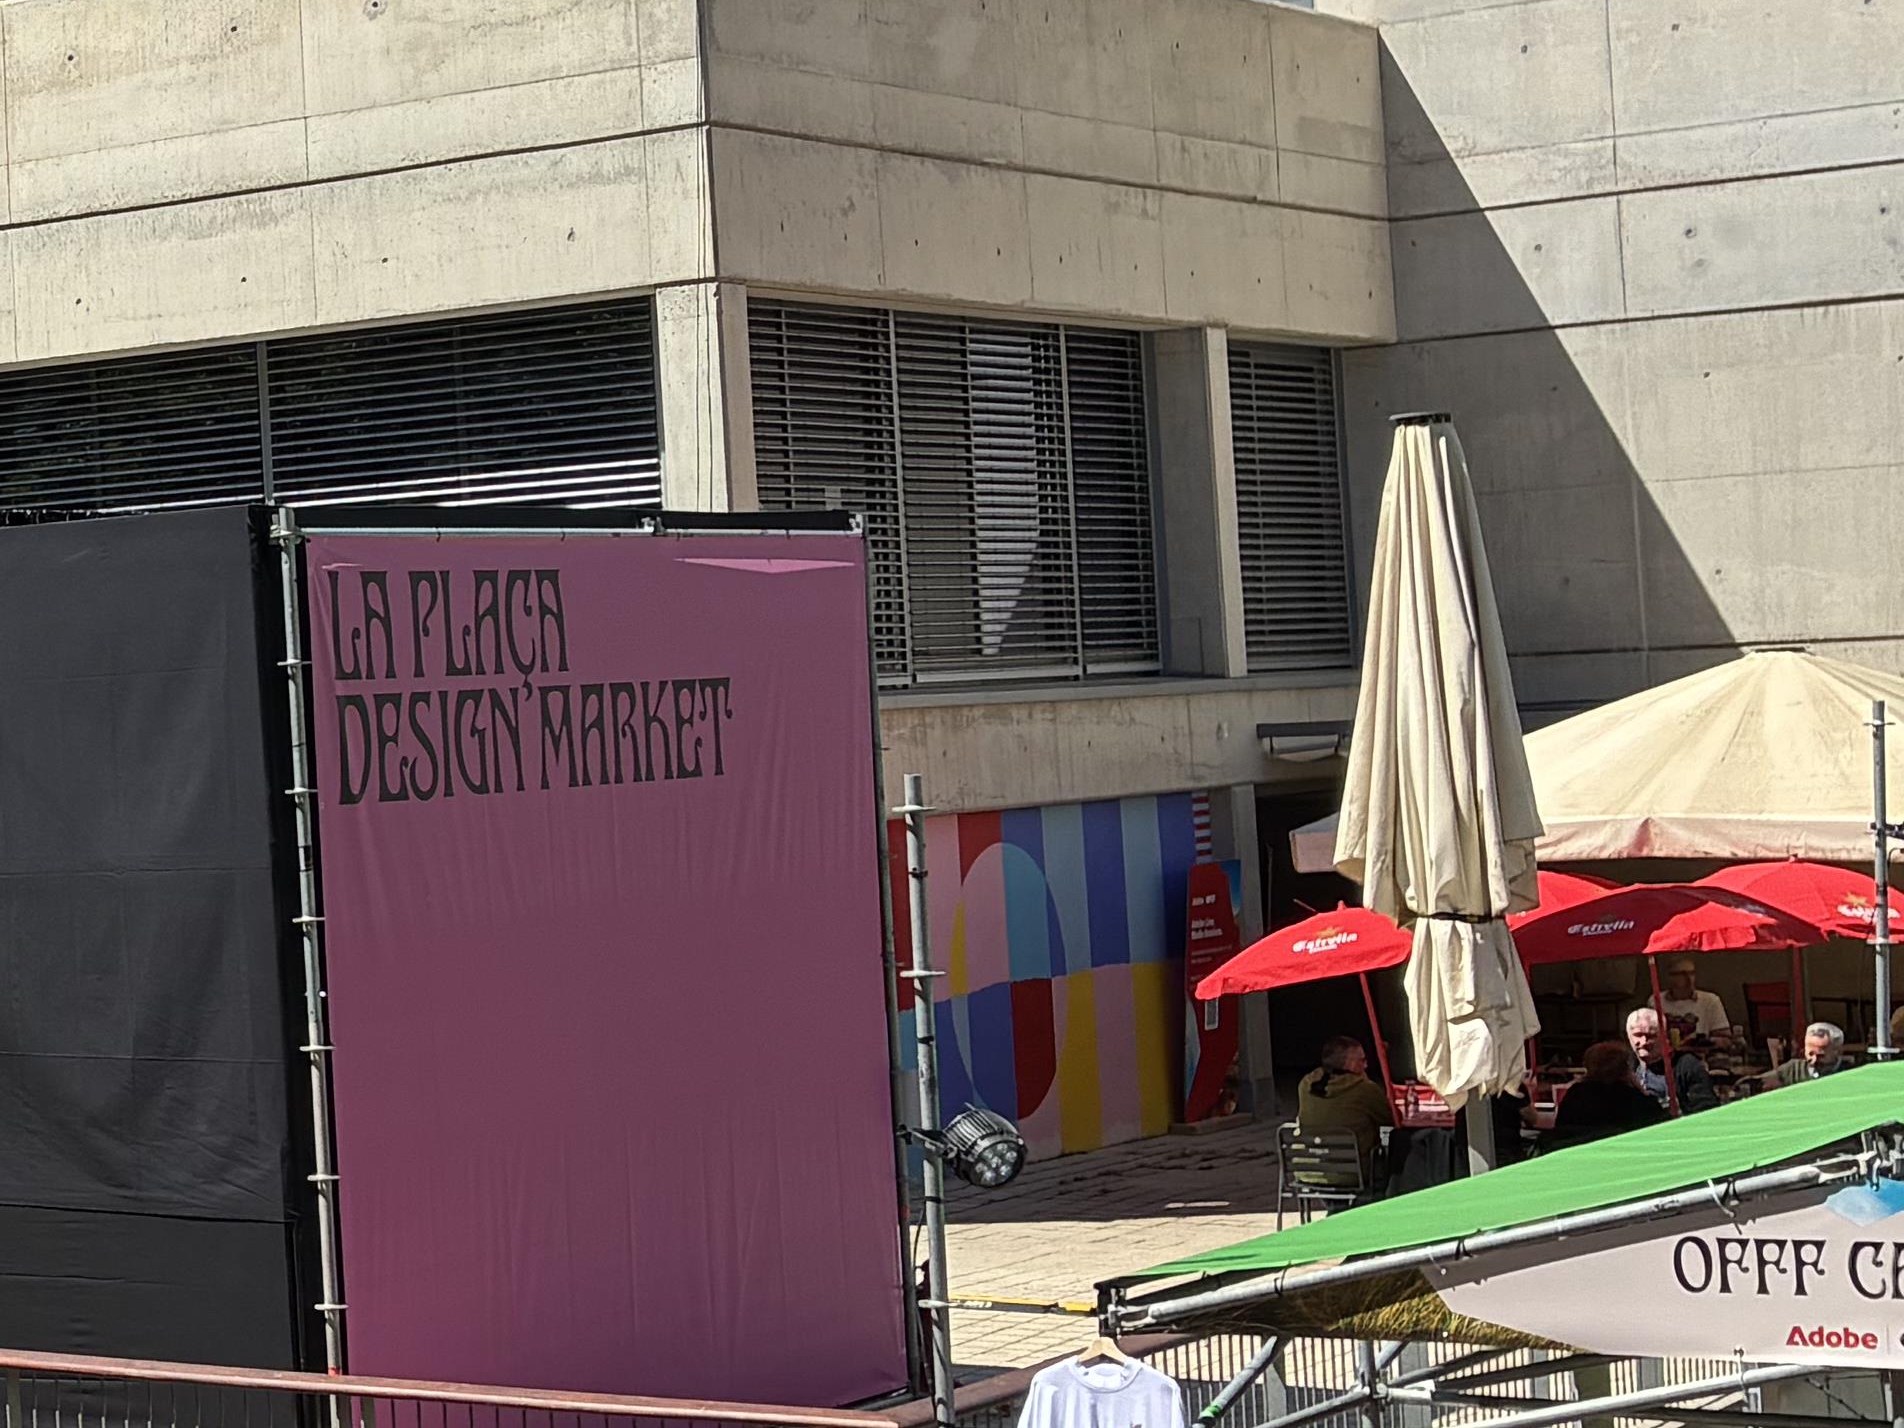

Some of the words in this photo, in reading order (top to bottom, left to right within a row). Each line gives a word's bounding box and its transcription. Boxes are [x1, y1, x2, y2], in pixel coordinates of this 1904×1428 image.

[327, 570, 394, 681] LA
[407, 568, 570, 701] PLAÇA
[336, 686, 526, 806] DESIGN
[537, 677, 734, 790] MARKET
[1673, 1235, 1827, 1297] OFFF
[1785, 1325, 1879, 1350] Adobe
